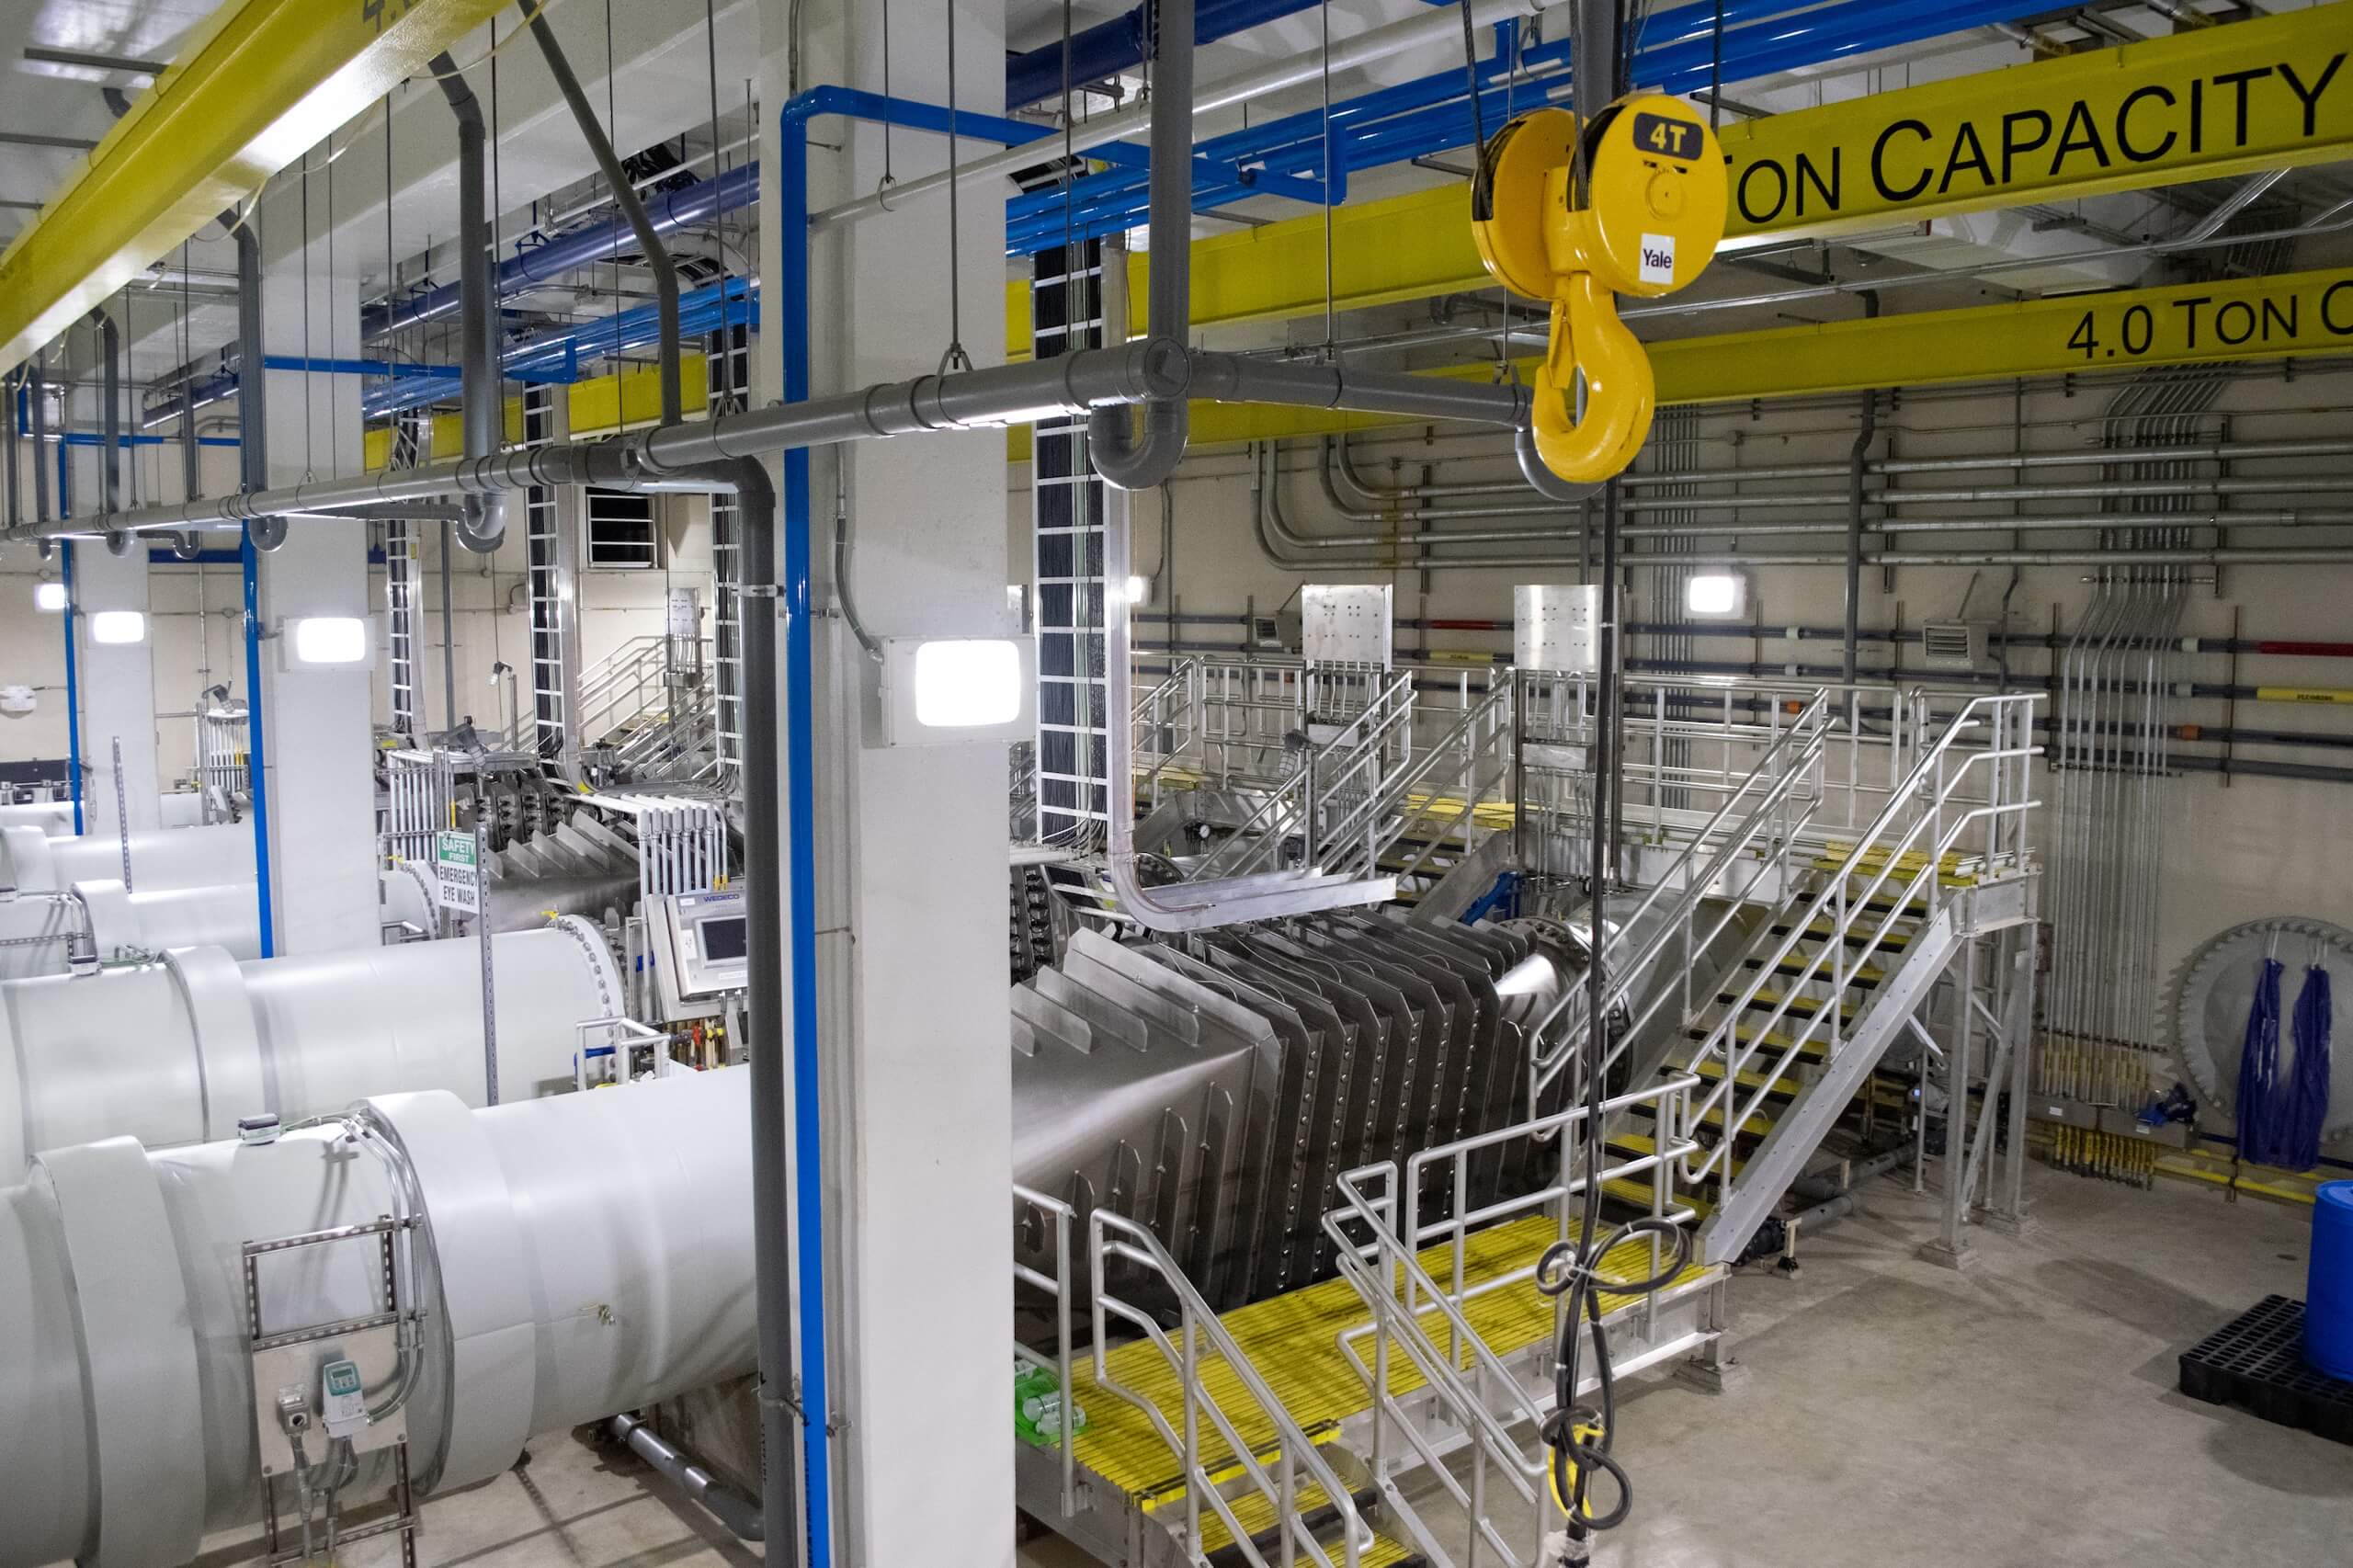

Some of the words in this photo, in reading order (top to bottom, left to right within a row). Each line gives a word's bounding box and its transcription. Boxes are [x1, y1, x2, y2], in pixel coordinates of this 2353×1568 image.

[1650, 122, 1687, 153] 4T
[1724, 146, 1840, 223] ON
[1870, 52, 2349, 201] CAPACITY
[1643, 248, 1673, 268] Yale
[2067, 304, 2154, 359] 4.0
[2173, 294, 2298, 349] TON
[442, 838, 476, 855] SAFETY
[449, 852, 470, 862] FIRST
[439, 866, 479, 887] EMERGENCY
[443, 885, 456, 903] EYE
[457, 888, 475, 905] WASH
